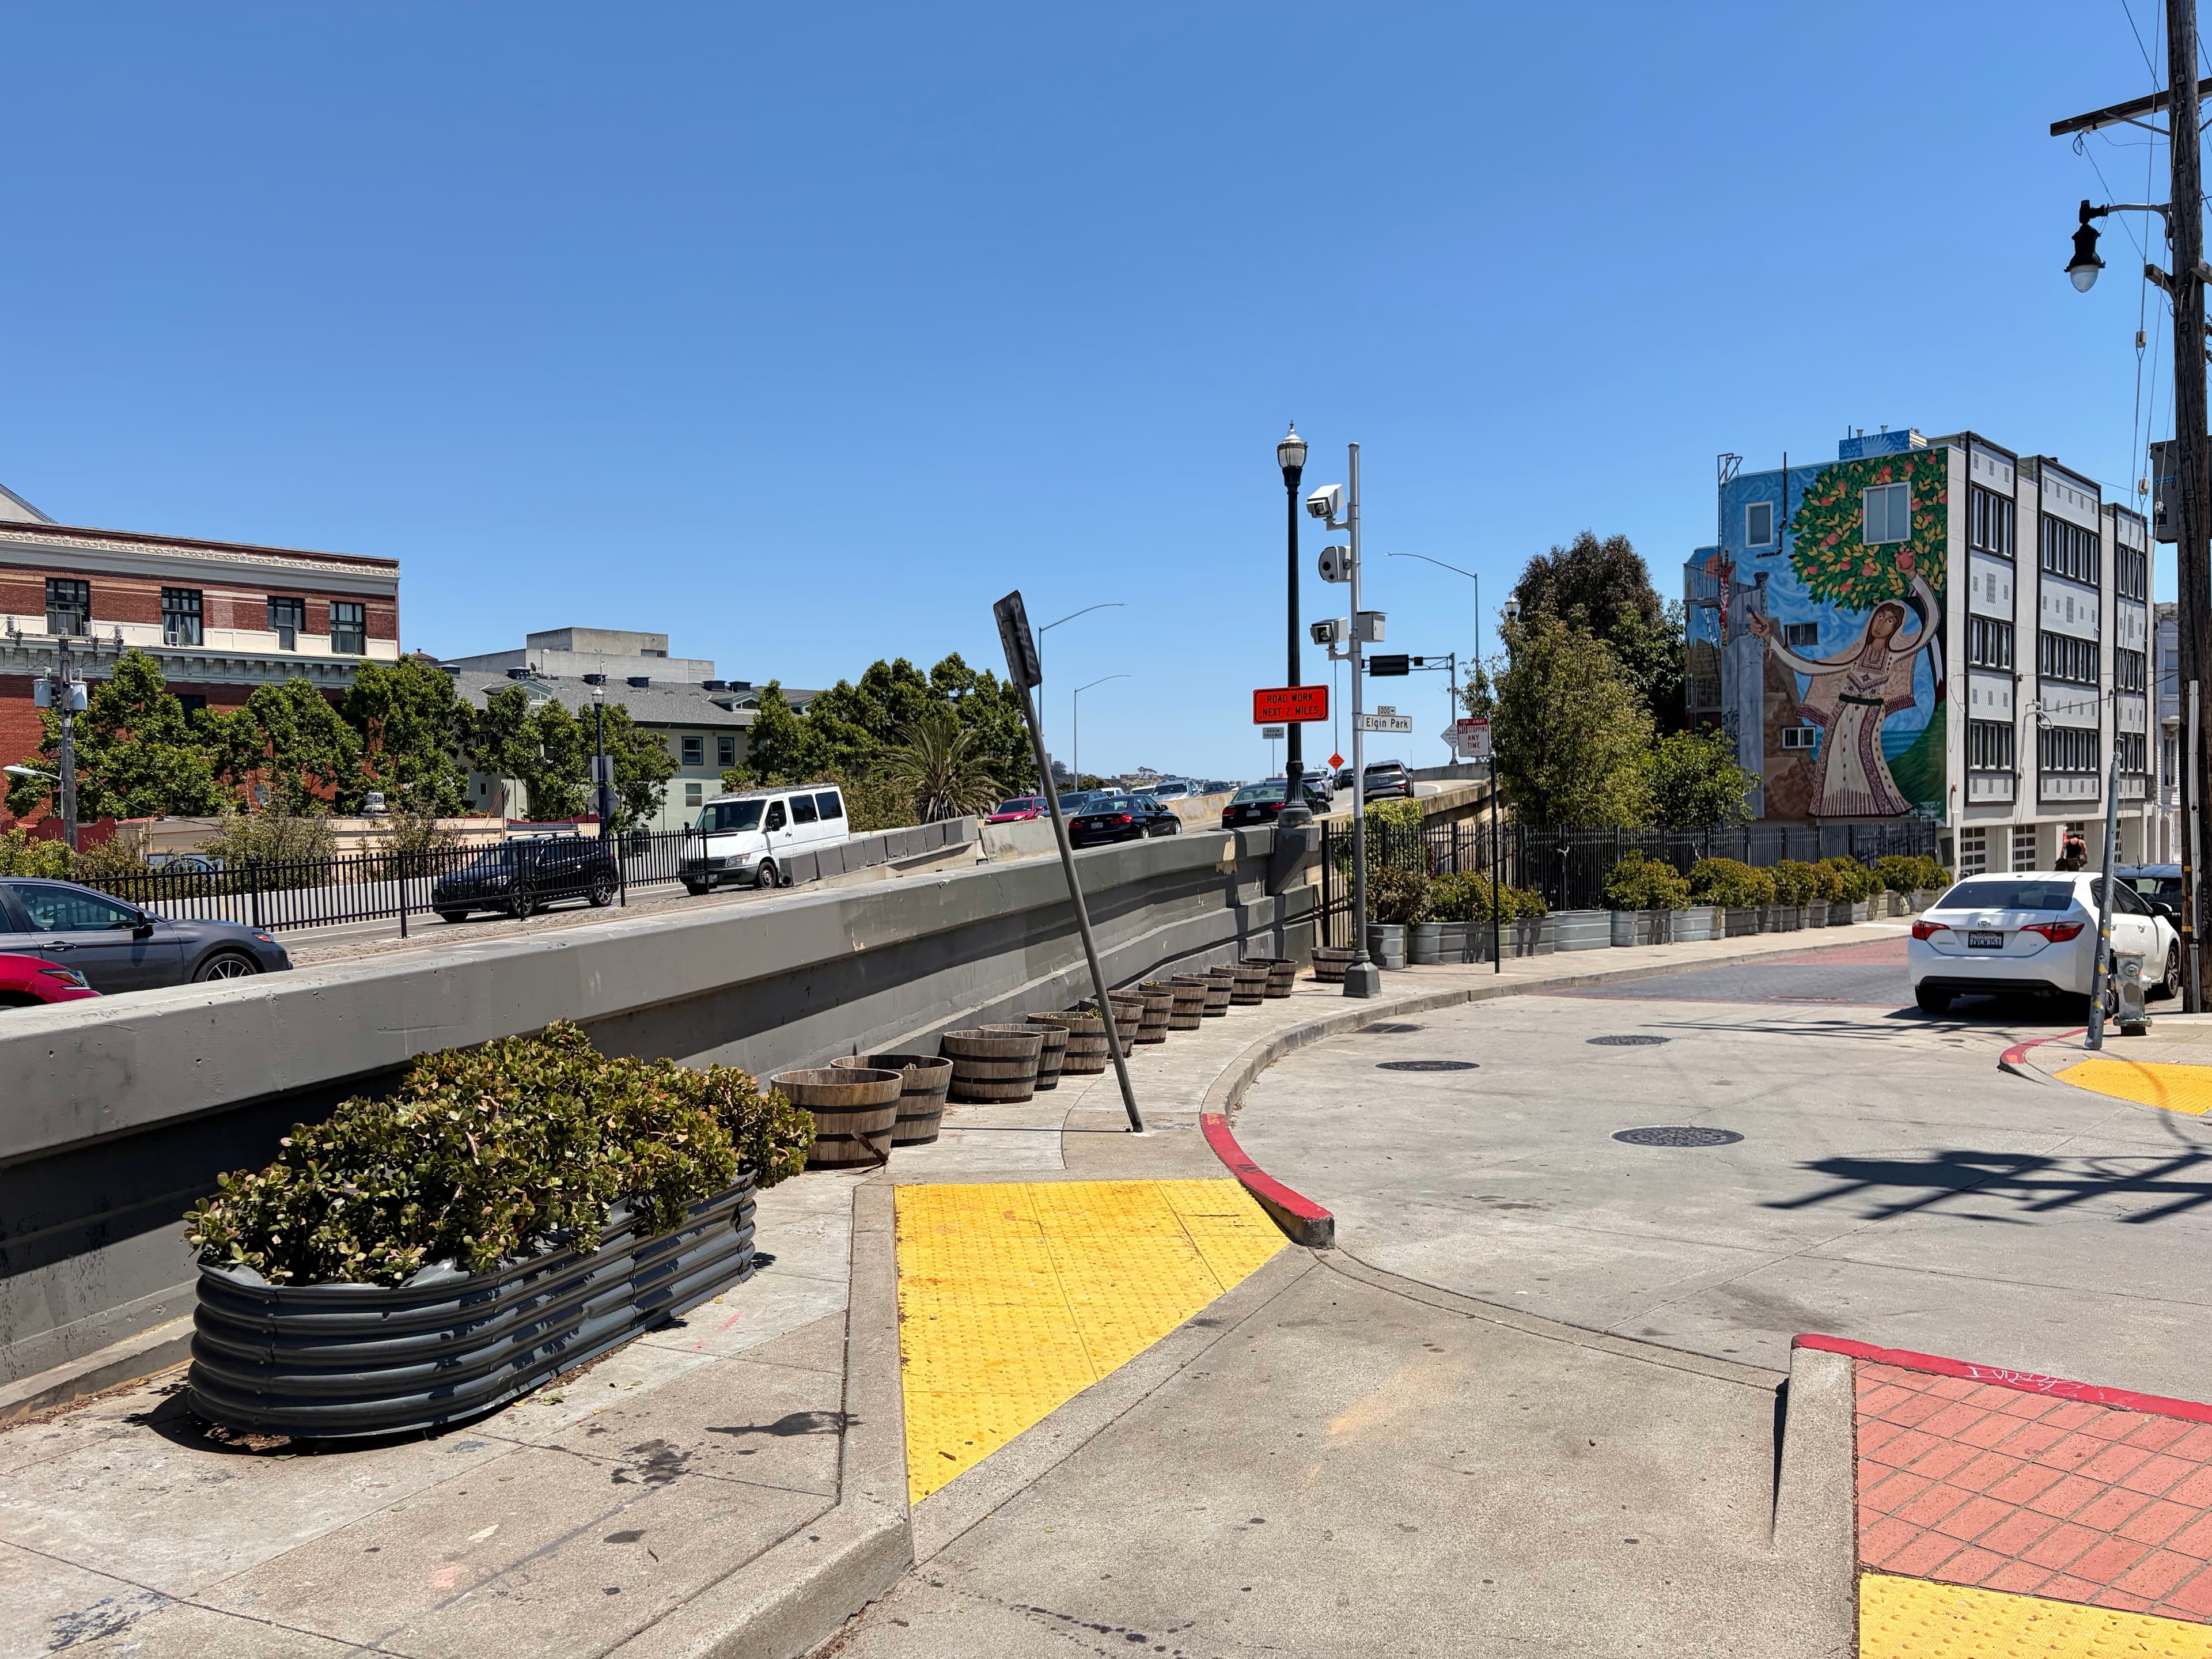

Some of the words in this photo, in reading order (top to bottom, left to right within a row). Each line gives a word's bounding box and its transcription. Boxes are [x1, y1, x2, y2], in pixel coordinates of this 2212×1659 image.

[1267, 695, 1287, 704] ROAD
[1291, 692, 1313, 702] WORK
[1262, 707, 1281, 717] NEXT
[1286, 707, 1290, 715] 2
[1295, 706, 1319, 715] MILES
[1366, 717, 1387, 730] Elgin
[1391, 718, 1408, 729] Park
[1458, 725, 1467, 733] NO
